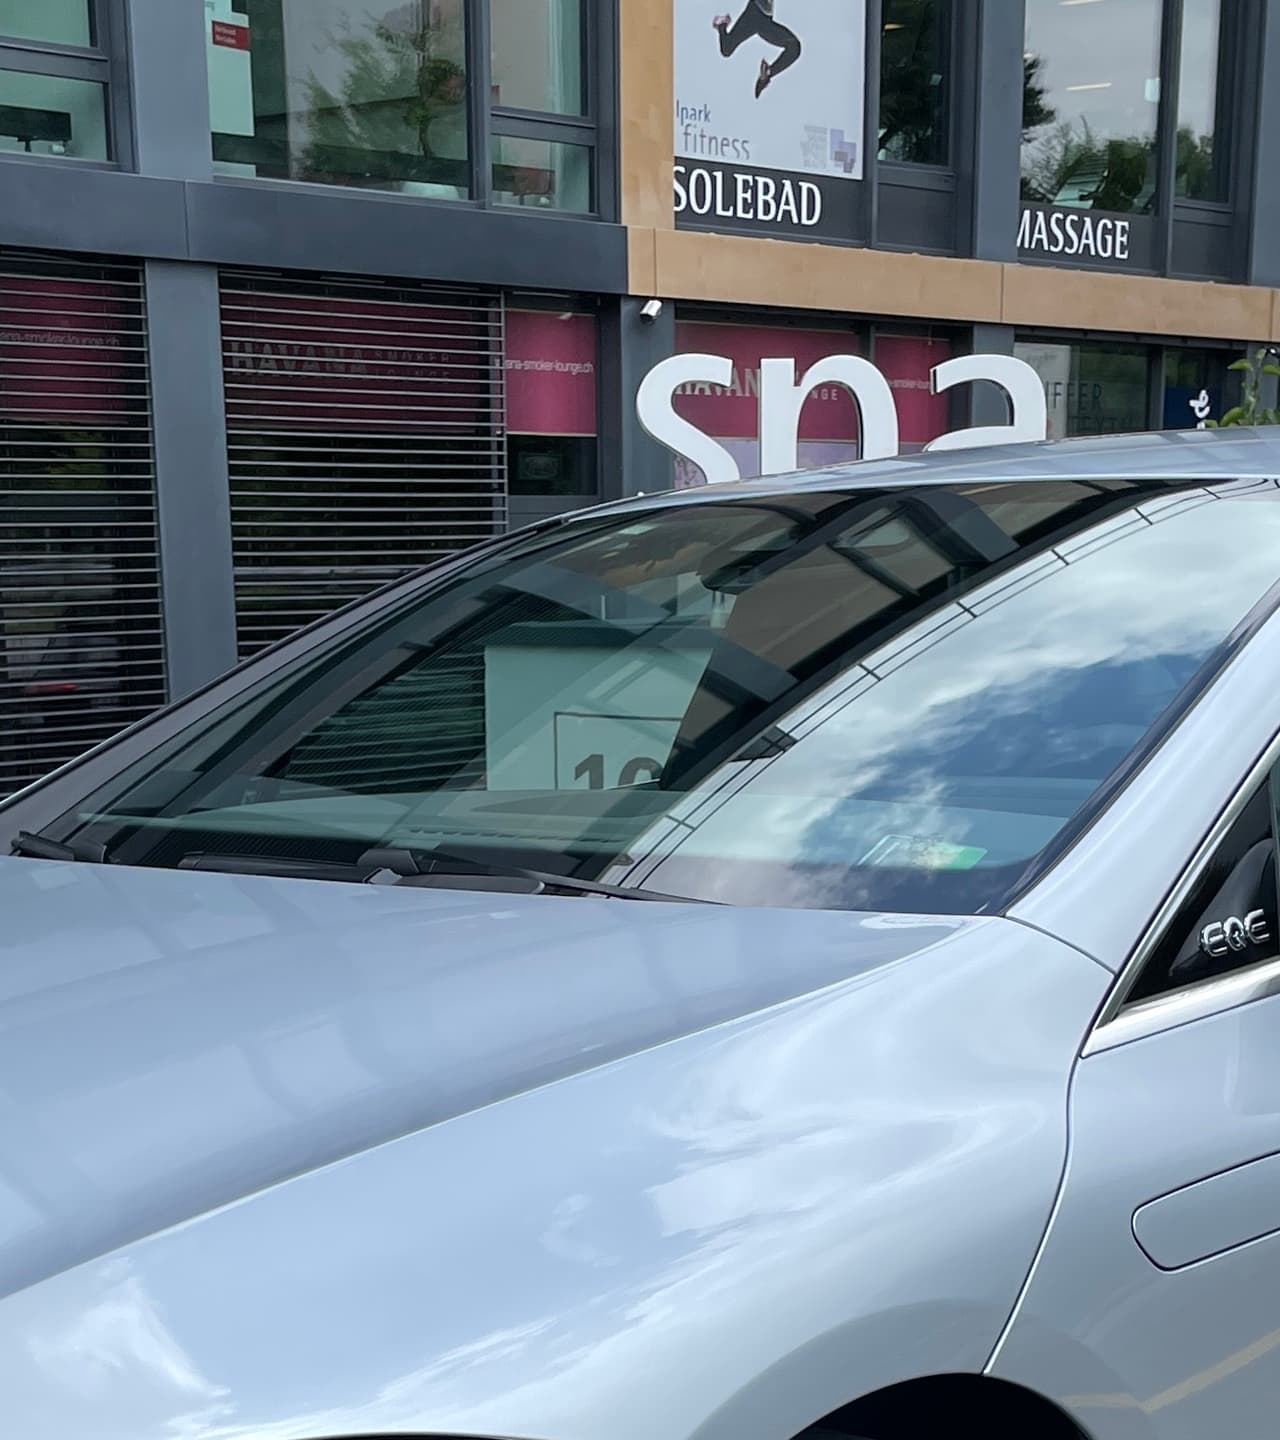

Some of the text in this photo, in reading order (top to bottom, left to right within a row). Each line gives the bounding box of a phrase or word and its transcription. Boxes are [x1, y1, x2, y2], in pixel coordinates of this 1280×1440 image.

[682, 124, 750, 160] fitness
[673, 164, 822, 226] SOLEBAD
[1201, 908, 1271, 957] EQE
